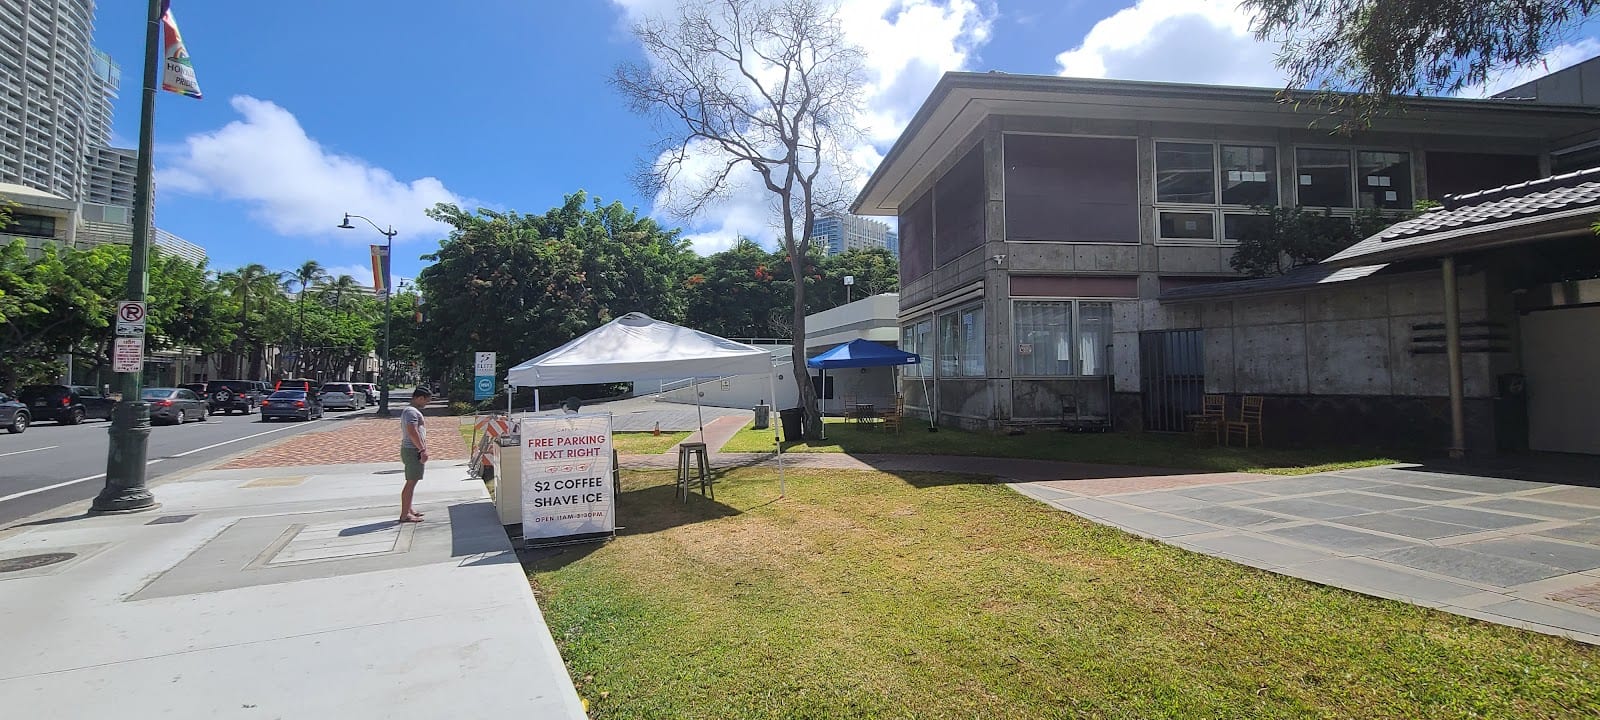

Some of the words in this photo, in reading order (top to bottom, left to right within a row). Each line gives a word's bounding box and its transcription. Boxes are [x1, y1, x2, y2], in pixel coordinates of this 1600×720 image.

[528, 438, 554, 448] FREE
[557, 435, 606, 446] PARKING
[534, 449, 564, 460] NEXT
[567, 447, 601, 458] RIGHT
[534, 480, 551, 493] $2
[554, 477, 602, 490] COFFEE
[534, 495, 578, 508] SHAVE
[582, 492, 602, 503] ICE
